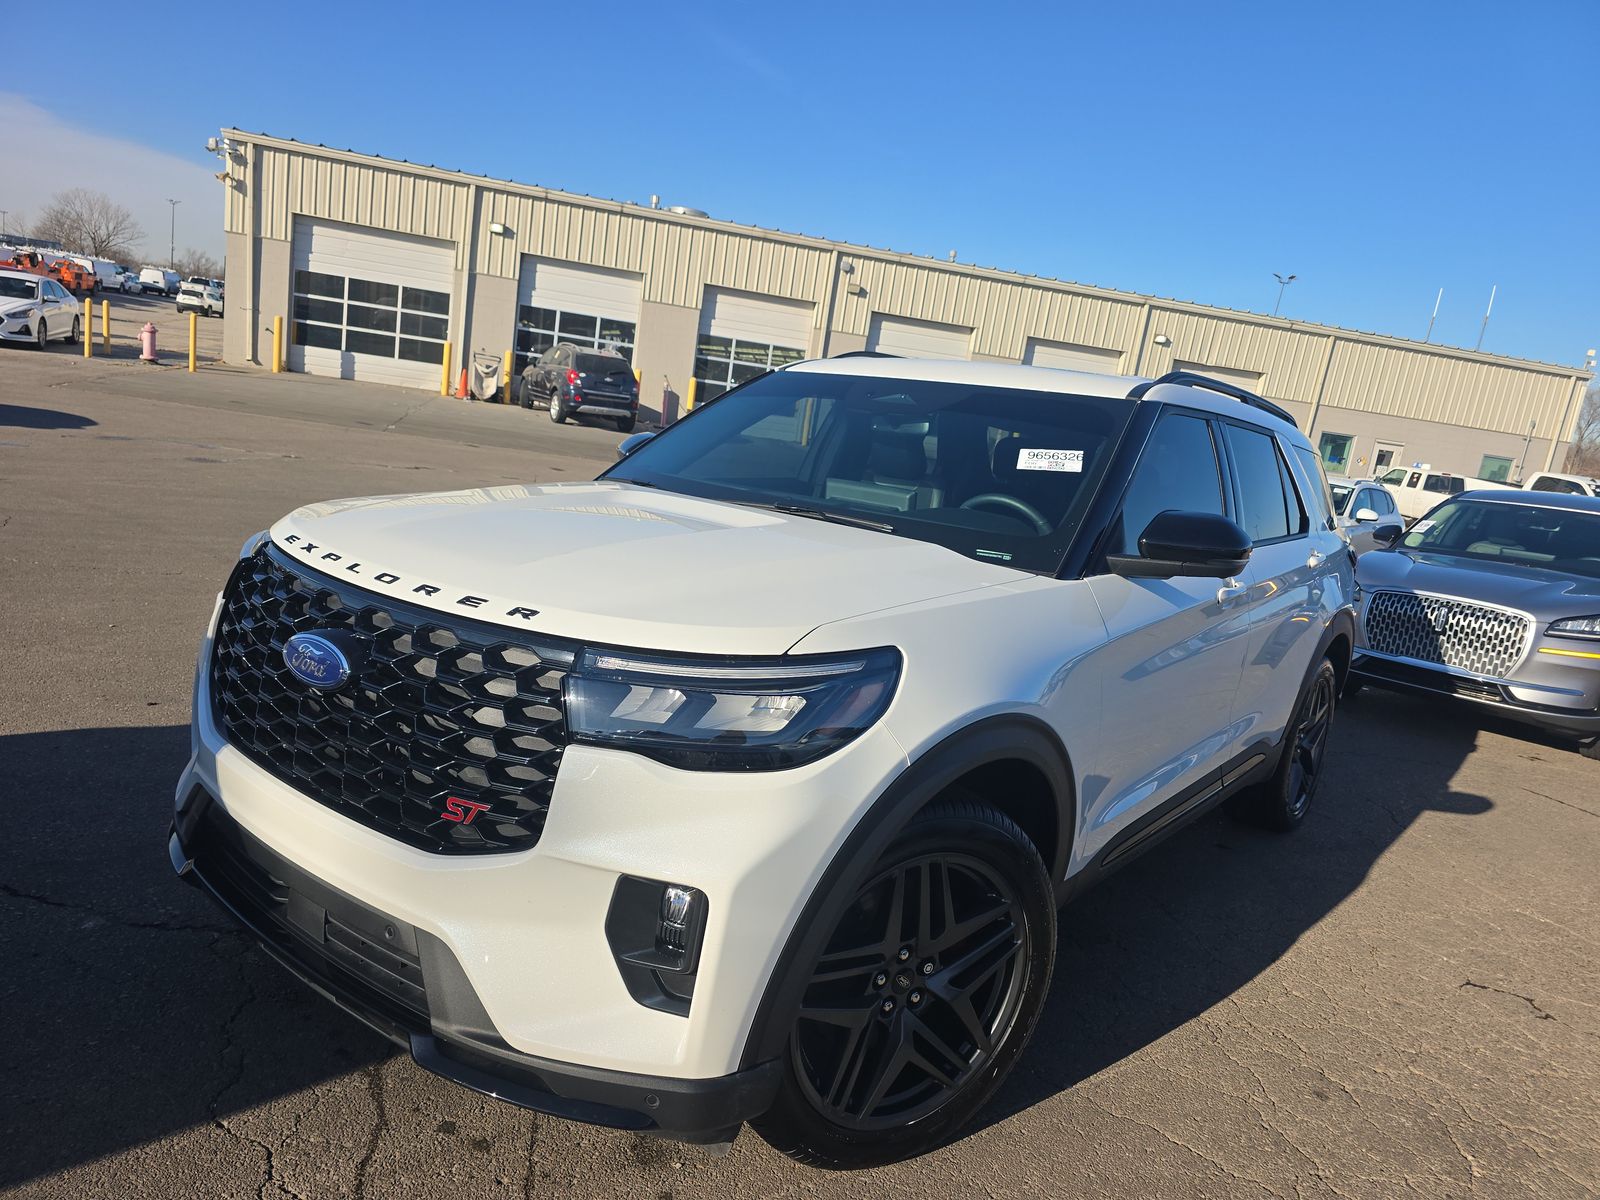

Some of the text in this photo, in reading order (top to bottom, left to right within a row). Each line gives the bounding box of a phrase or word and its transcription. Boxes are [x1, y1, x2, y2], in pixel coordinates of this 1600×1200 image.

[1027, 451, 1083, 461] 9656326
[284, 534, 541, 621] EXPLORER
[291, 643, 331, 678] Ford
[440, 797, 491, 825] ST
